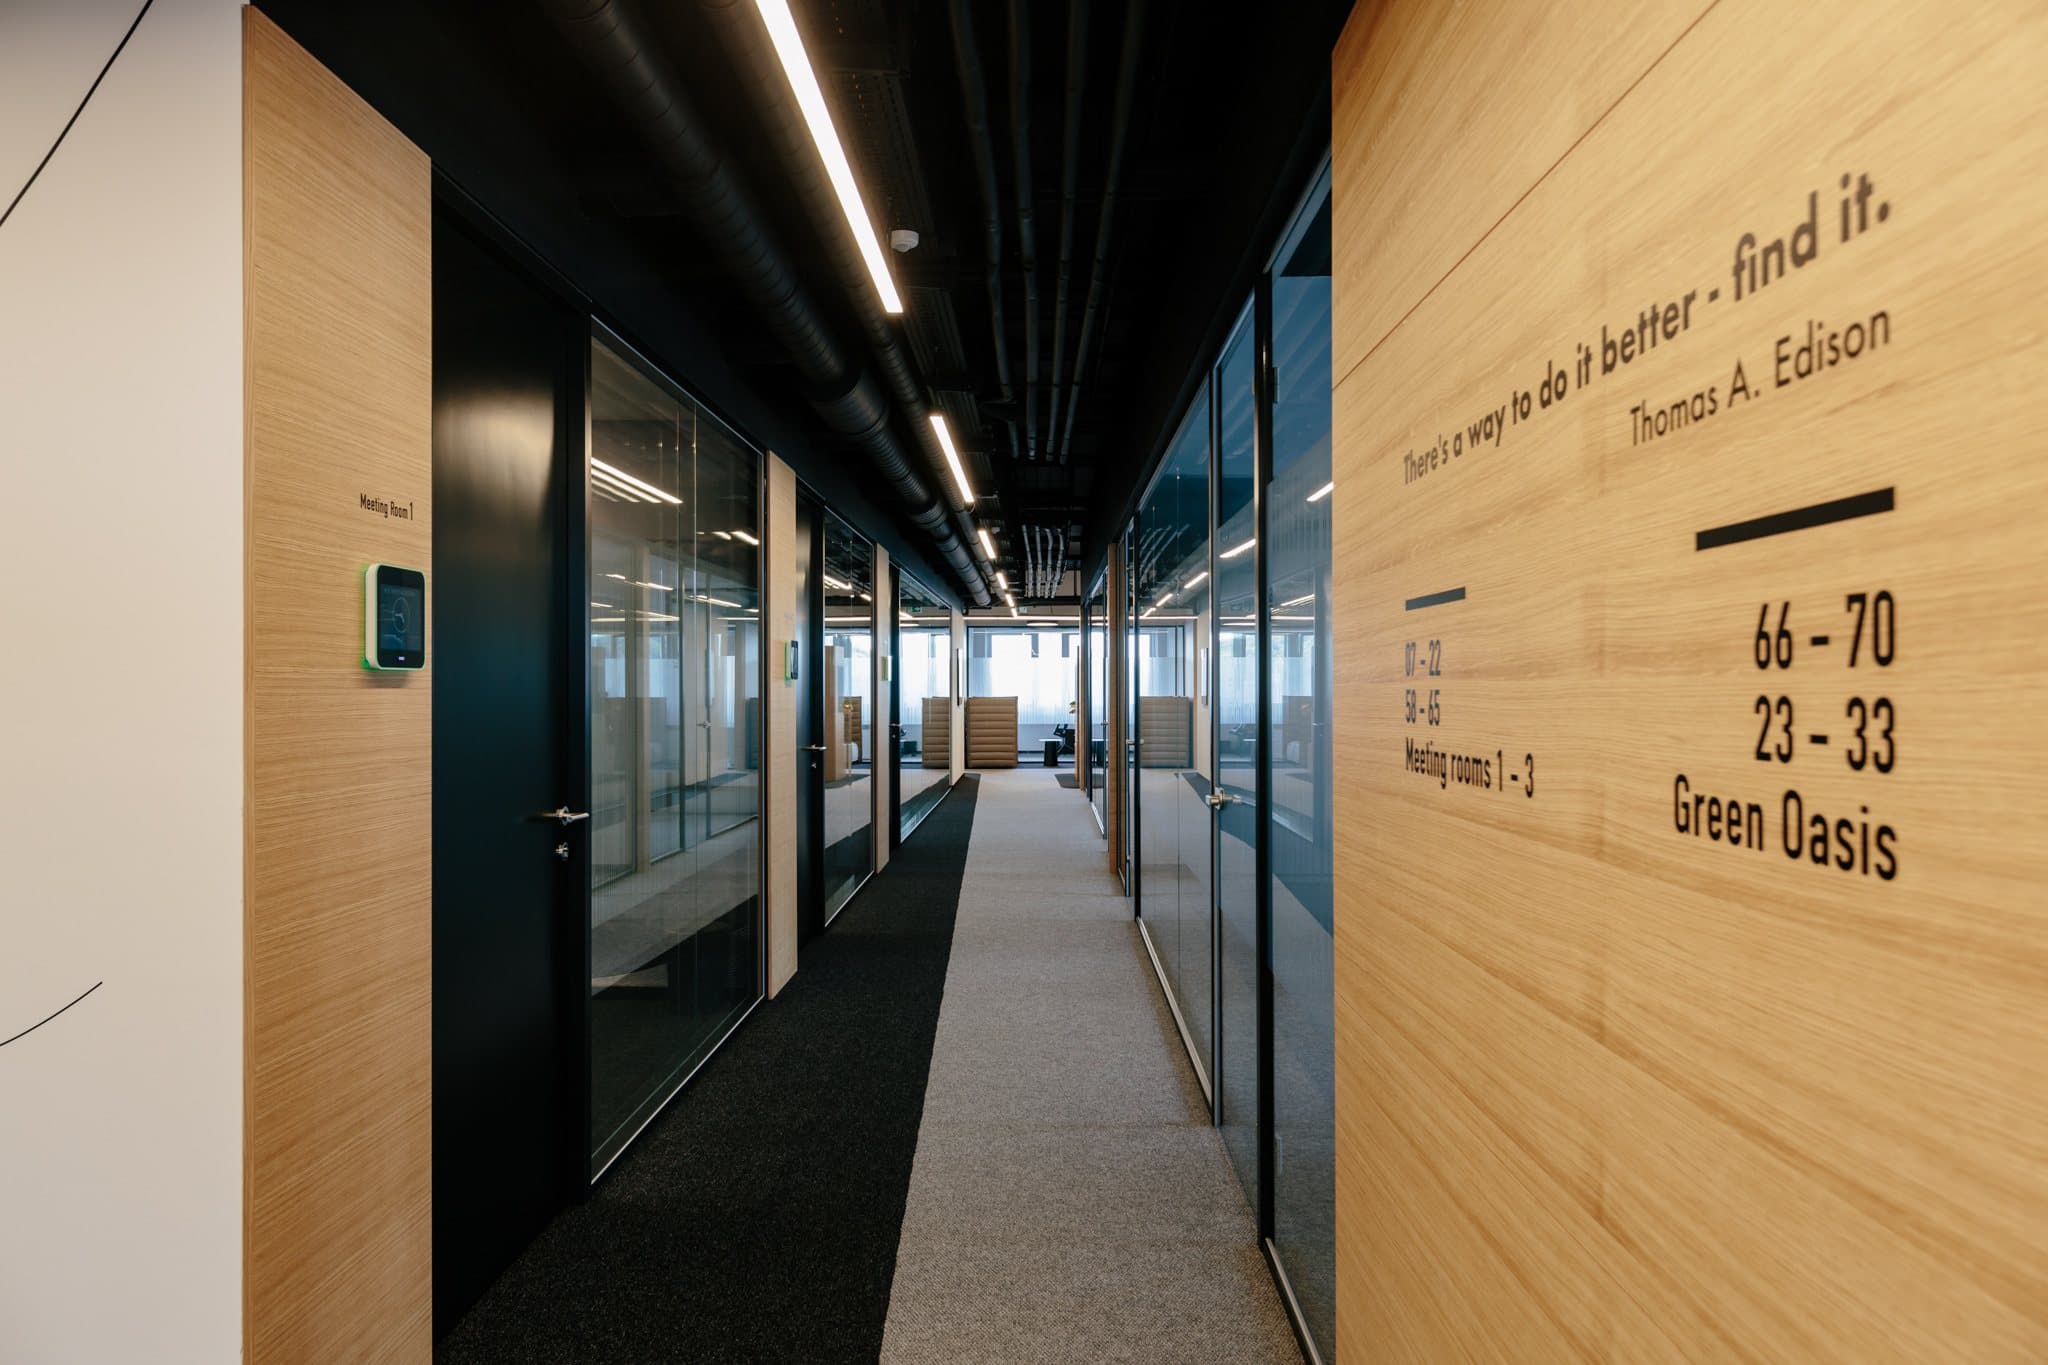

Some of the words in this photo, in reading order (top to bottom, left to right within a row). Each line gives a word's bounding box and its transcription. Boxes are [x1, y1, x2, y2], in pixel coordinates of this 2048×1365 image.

[1403, 435, 1448, 485] There's
[1453, 432, 1462, 458] a
[1467, 405, 1506, 448] way
[1512, 390, 1531, 425] to
[1539, 360, 1568, 409] do
[1576, 343, 1592, 389] it
[1602, 289, 1697, 376] better
[1733, 189, 1818, 302] find
[1840, 172, 1890, 244] it.
[1630, 387, 1718, 447] Thomas
[1728, 360, 1760, 408] A.
[1775, 310, 1889, 388] Edison
[360, 493, 388, 519] Meeting
[390, 501, 408, 520] Room
[409, 502, 413, 521] 1
[1755, 601, 1793, 670] 66
[1846, 590, 1895, 669] 70
[1428, 689, 1440, 726] 65
[1755, 695, 1793, 763] 23
[1846, 697, 1895, 774] 33
[1405, 737, 1447, 789] Meeting
[1451, 753, 1491, 789] rooms
[1497, 749, 1503, 792] 1
[1525, 753, 1534, 798] 3
[1674, 774, 1764, 852] Green
[1782, 789, 1897, 881] Oasis
